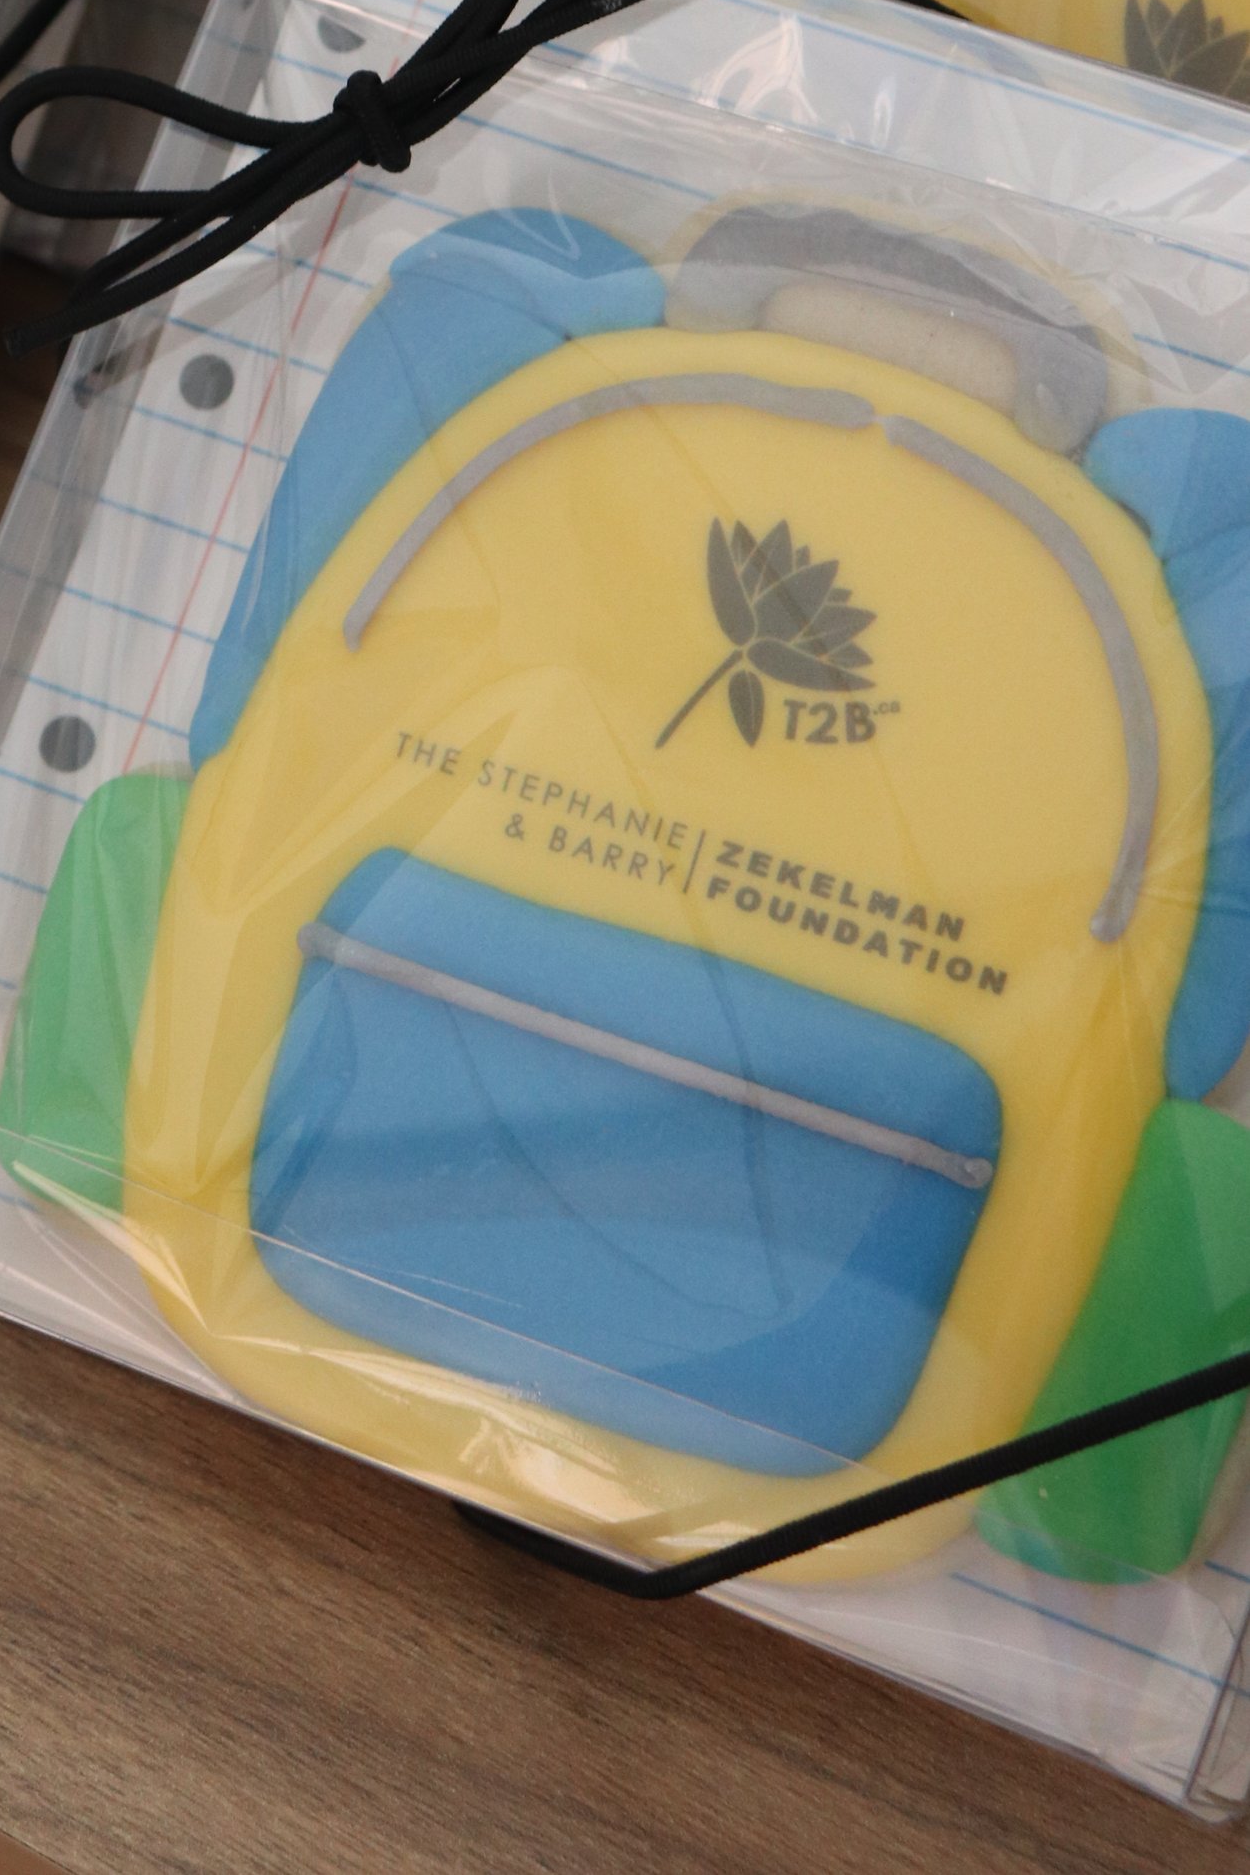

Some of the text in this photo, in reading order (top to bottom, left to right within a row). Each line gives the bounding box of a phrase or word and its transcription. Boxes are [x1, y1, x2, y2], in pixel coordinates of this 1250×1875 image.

[395, 731, 689, 851] THE STEPHANIE
[503, 813, 677, 887] & BARRY
[714, 839, 966, 942] ZEKELMAN
[706, 876, 1009, 996] FOUNDATION
